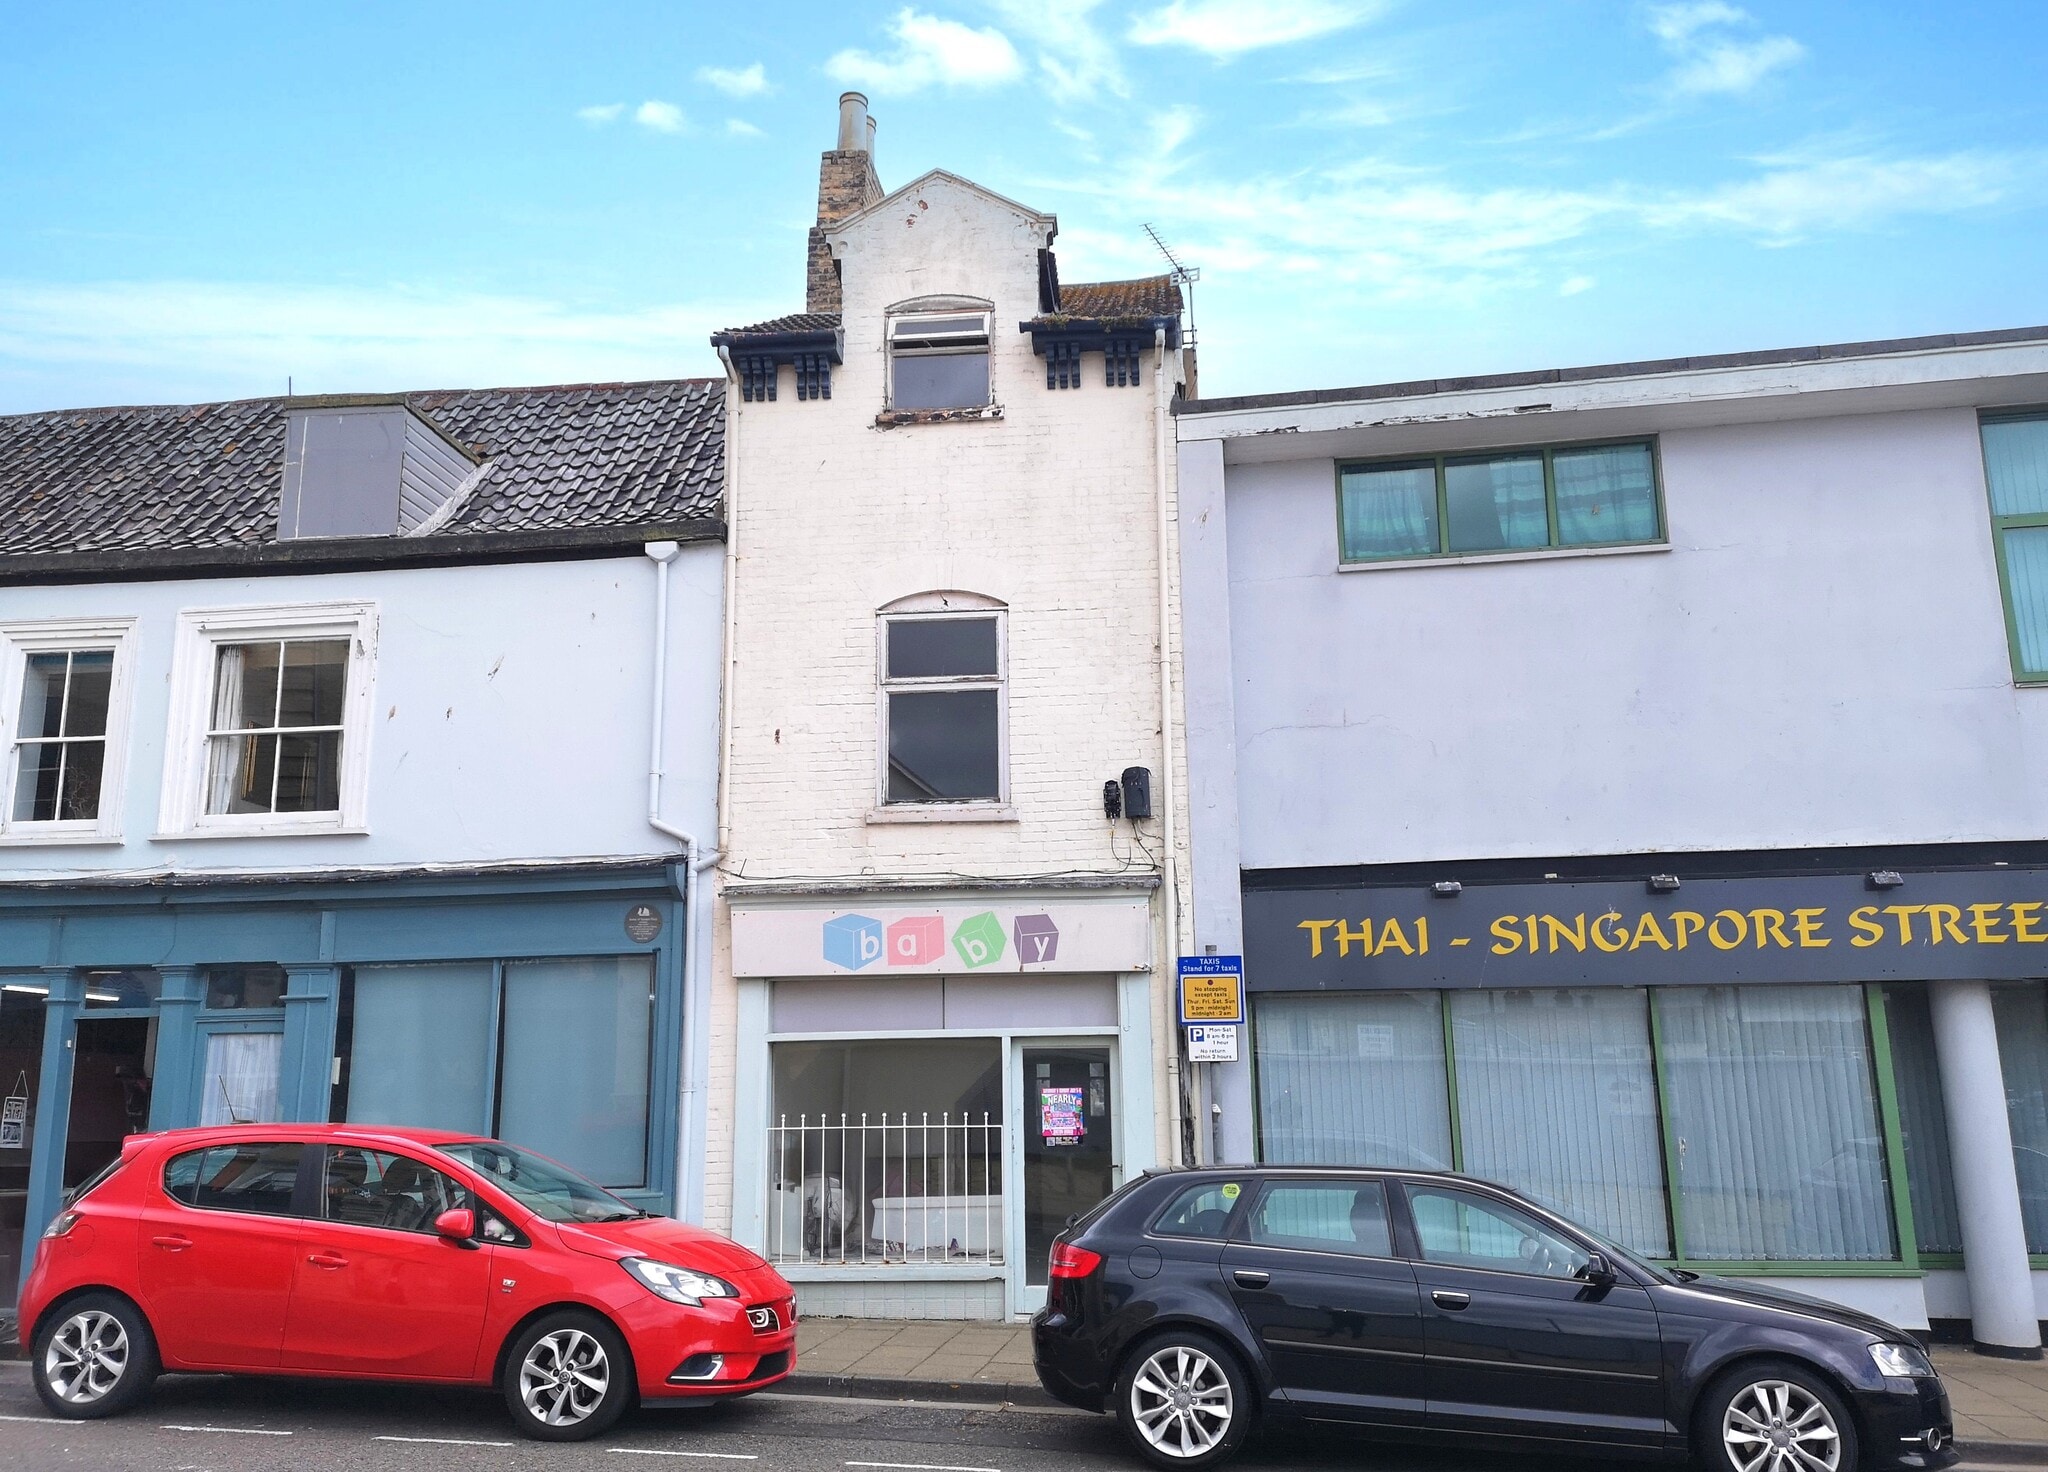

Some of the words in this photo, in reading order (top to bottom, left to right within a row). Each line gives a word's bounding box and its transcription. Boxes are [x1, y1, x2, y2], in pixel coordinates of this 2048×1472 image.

[1296, 916, 1428, 959] THAI
[1489, 907, 1833, 956] SINGAPORE
[1848, 901, 2048, 947] STREE
[1193, 1028, 1203, 1041] P
[1048, 1094, 1076, 1105] NEARLY
